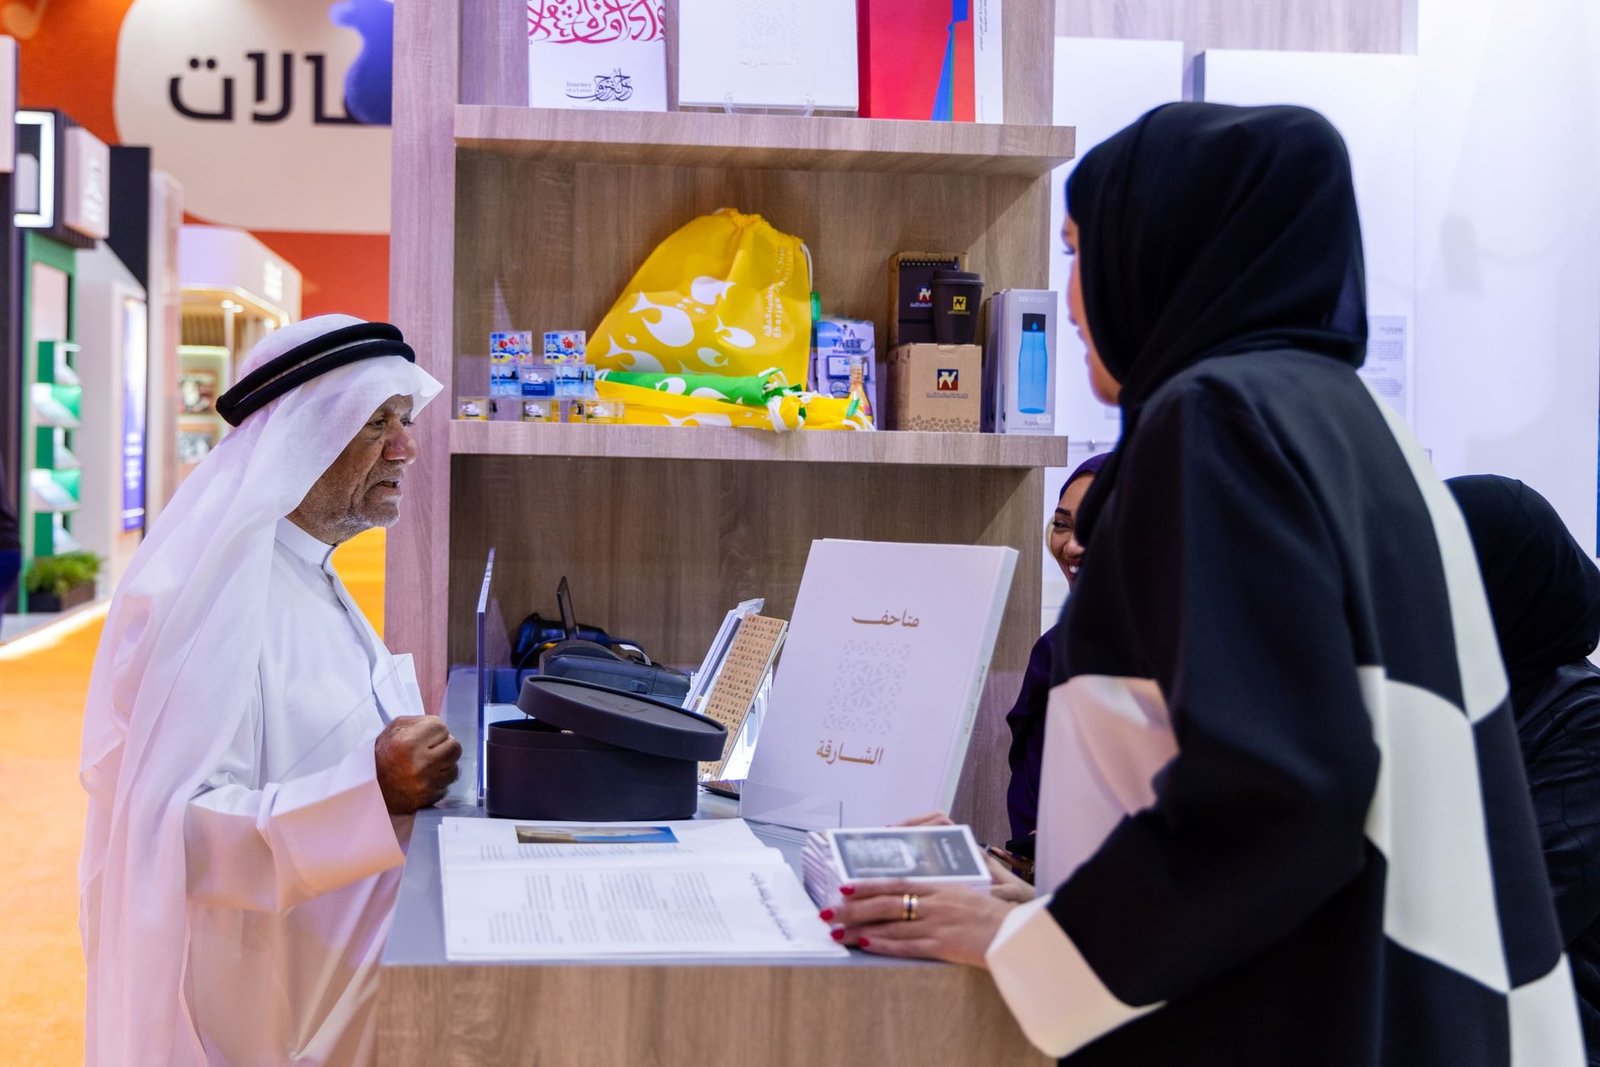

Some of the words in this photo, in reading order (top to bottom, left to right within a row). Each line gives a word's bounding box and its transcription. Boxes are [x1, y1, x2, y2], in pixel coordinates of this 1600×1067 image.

[169, 52, 392, 125] الات
[851, 609, 920, 628] متاحف
[815, 739, 885, 765] الشارقة
